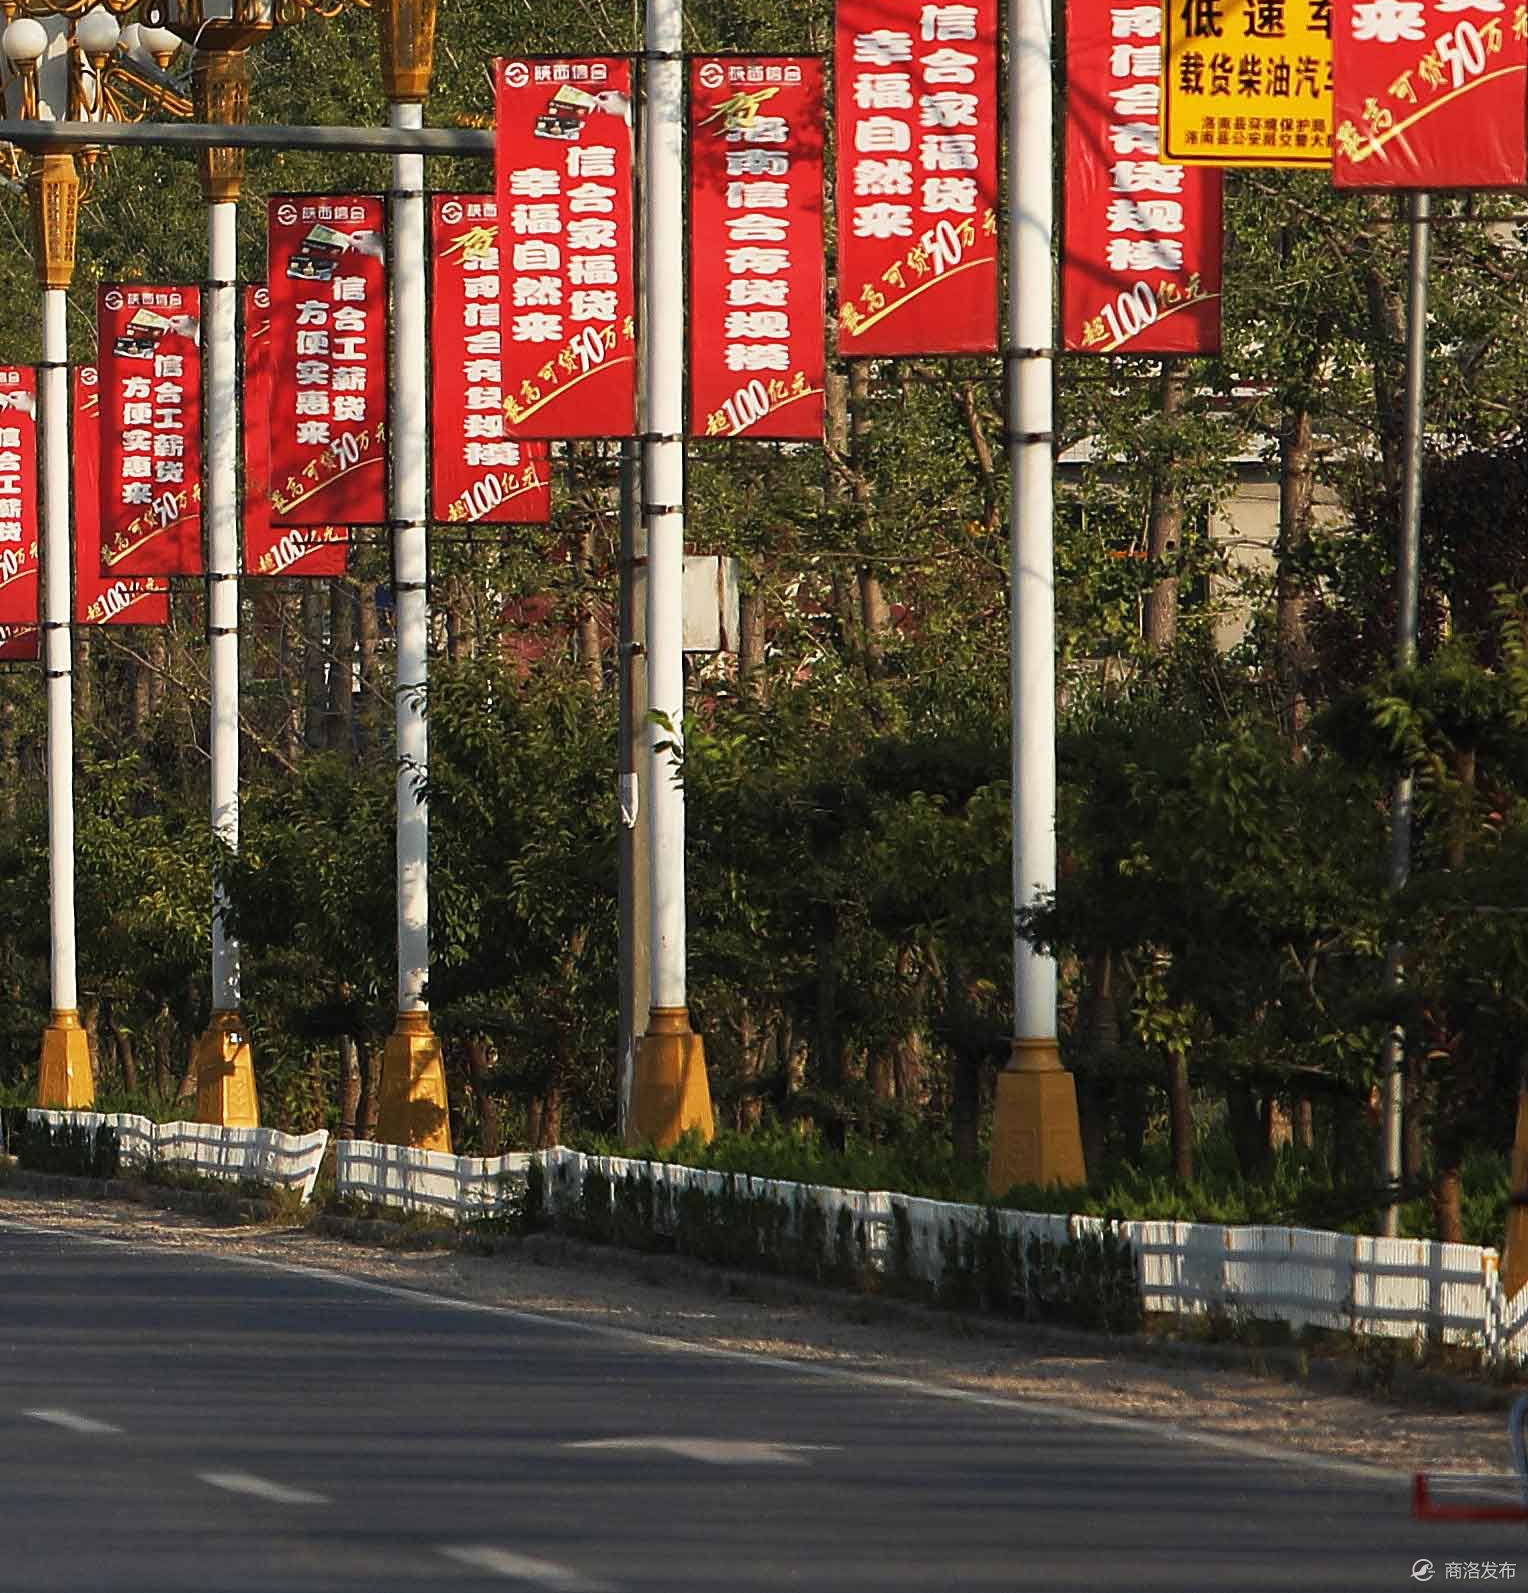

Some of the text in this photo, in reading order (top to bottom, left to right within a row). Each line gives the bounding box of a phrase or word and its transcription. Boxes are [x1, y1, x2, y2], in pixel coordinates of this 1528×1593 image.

[534, 63, 607, 81] 陕西信合
[852, 29, 914, 239] 幸福自然来
[919, 4, 978, 214] 信合家福贷
[508, 167, 562, 343] 幸福自然来
[565, 145, 618, 322] 信合家福贷
